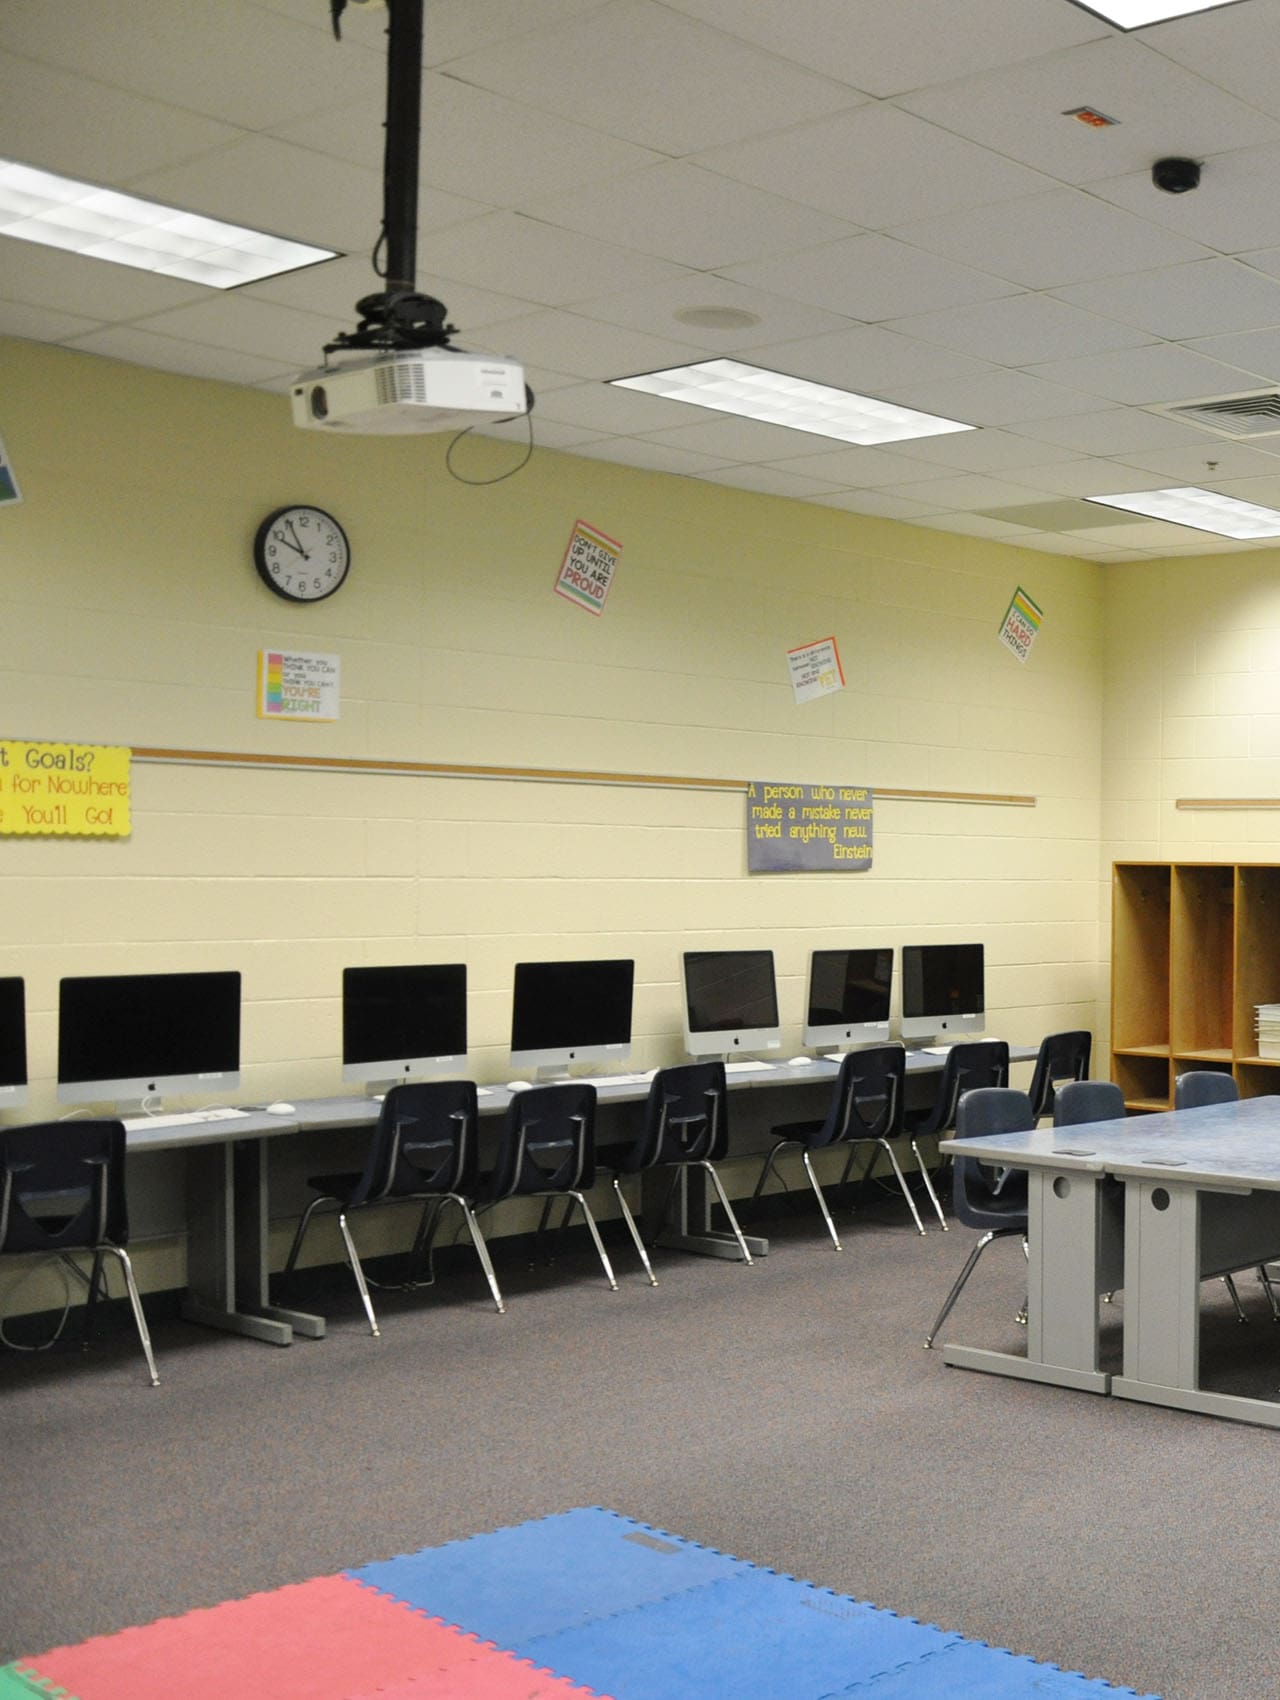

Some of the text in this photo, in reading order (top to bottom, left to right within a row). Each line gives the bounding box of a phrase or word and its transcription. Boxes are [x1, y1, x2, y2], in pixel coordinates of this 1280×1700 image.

[299, 516, 310, 528] 12
[326, 535, 334, 546] 2
[268, 545, 277, 557] 9
[329, 551, 337, 563] 3
[574, 533, 617, 567] DON'T GIVE
[272, 562, 280, 574] 8
[572, 543, 611, 576] UP UNTIL
[325, 568, 332, 577] 4
[570, 555, 609, 588] YOU ARE
[285, 575, 292, 586] 7
[298, 580, 306, 593] 6
[313, 577, 321, 589] 5
[563, 566, 605, 600] PROUD
[1007, 617, 1031, 647] HARD
[1002, 628, 1027, 658] THINGS
[282, 698, 321, 713] RIGHT
[25, 748, 95, 772] Goals?
[12, 773, 41, 793] for
[47, 775, 128, 797] Nowhere
[748, 782, 869, 804] A person who never
[84, 806, 113, 825] Go!
[751, 803, 874, 820] made a mistake never
[755, 822, 868, 844] tried anything new.
[832, 844, 873, 859] Einstein
